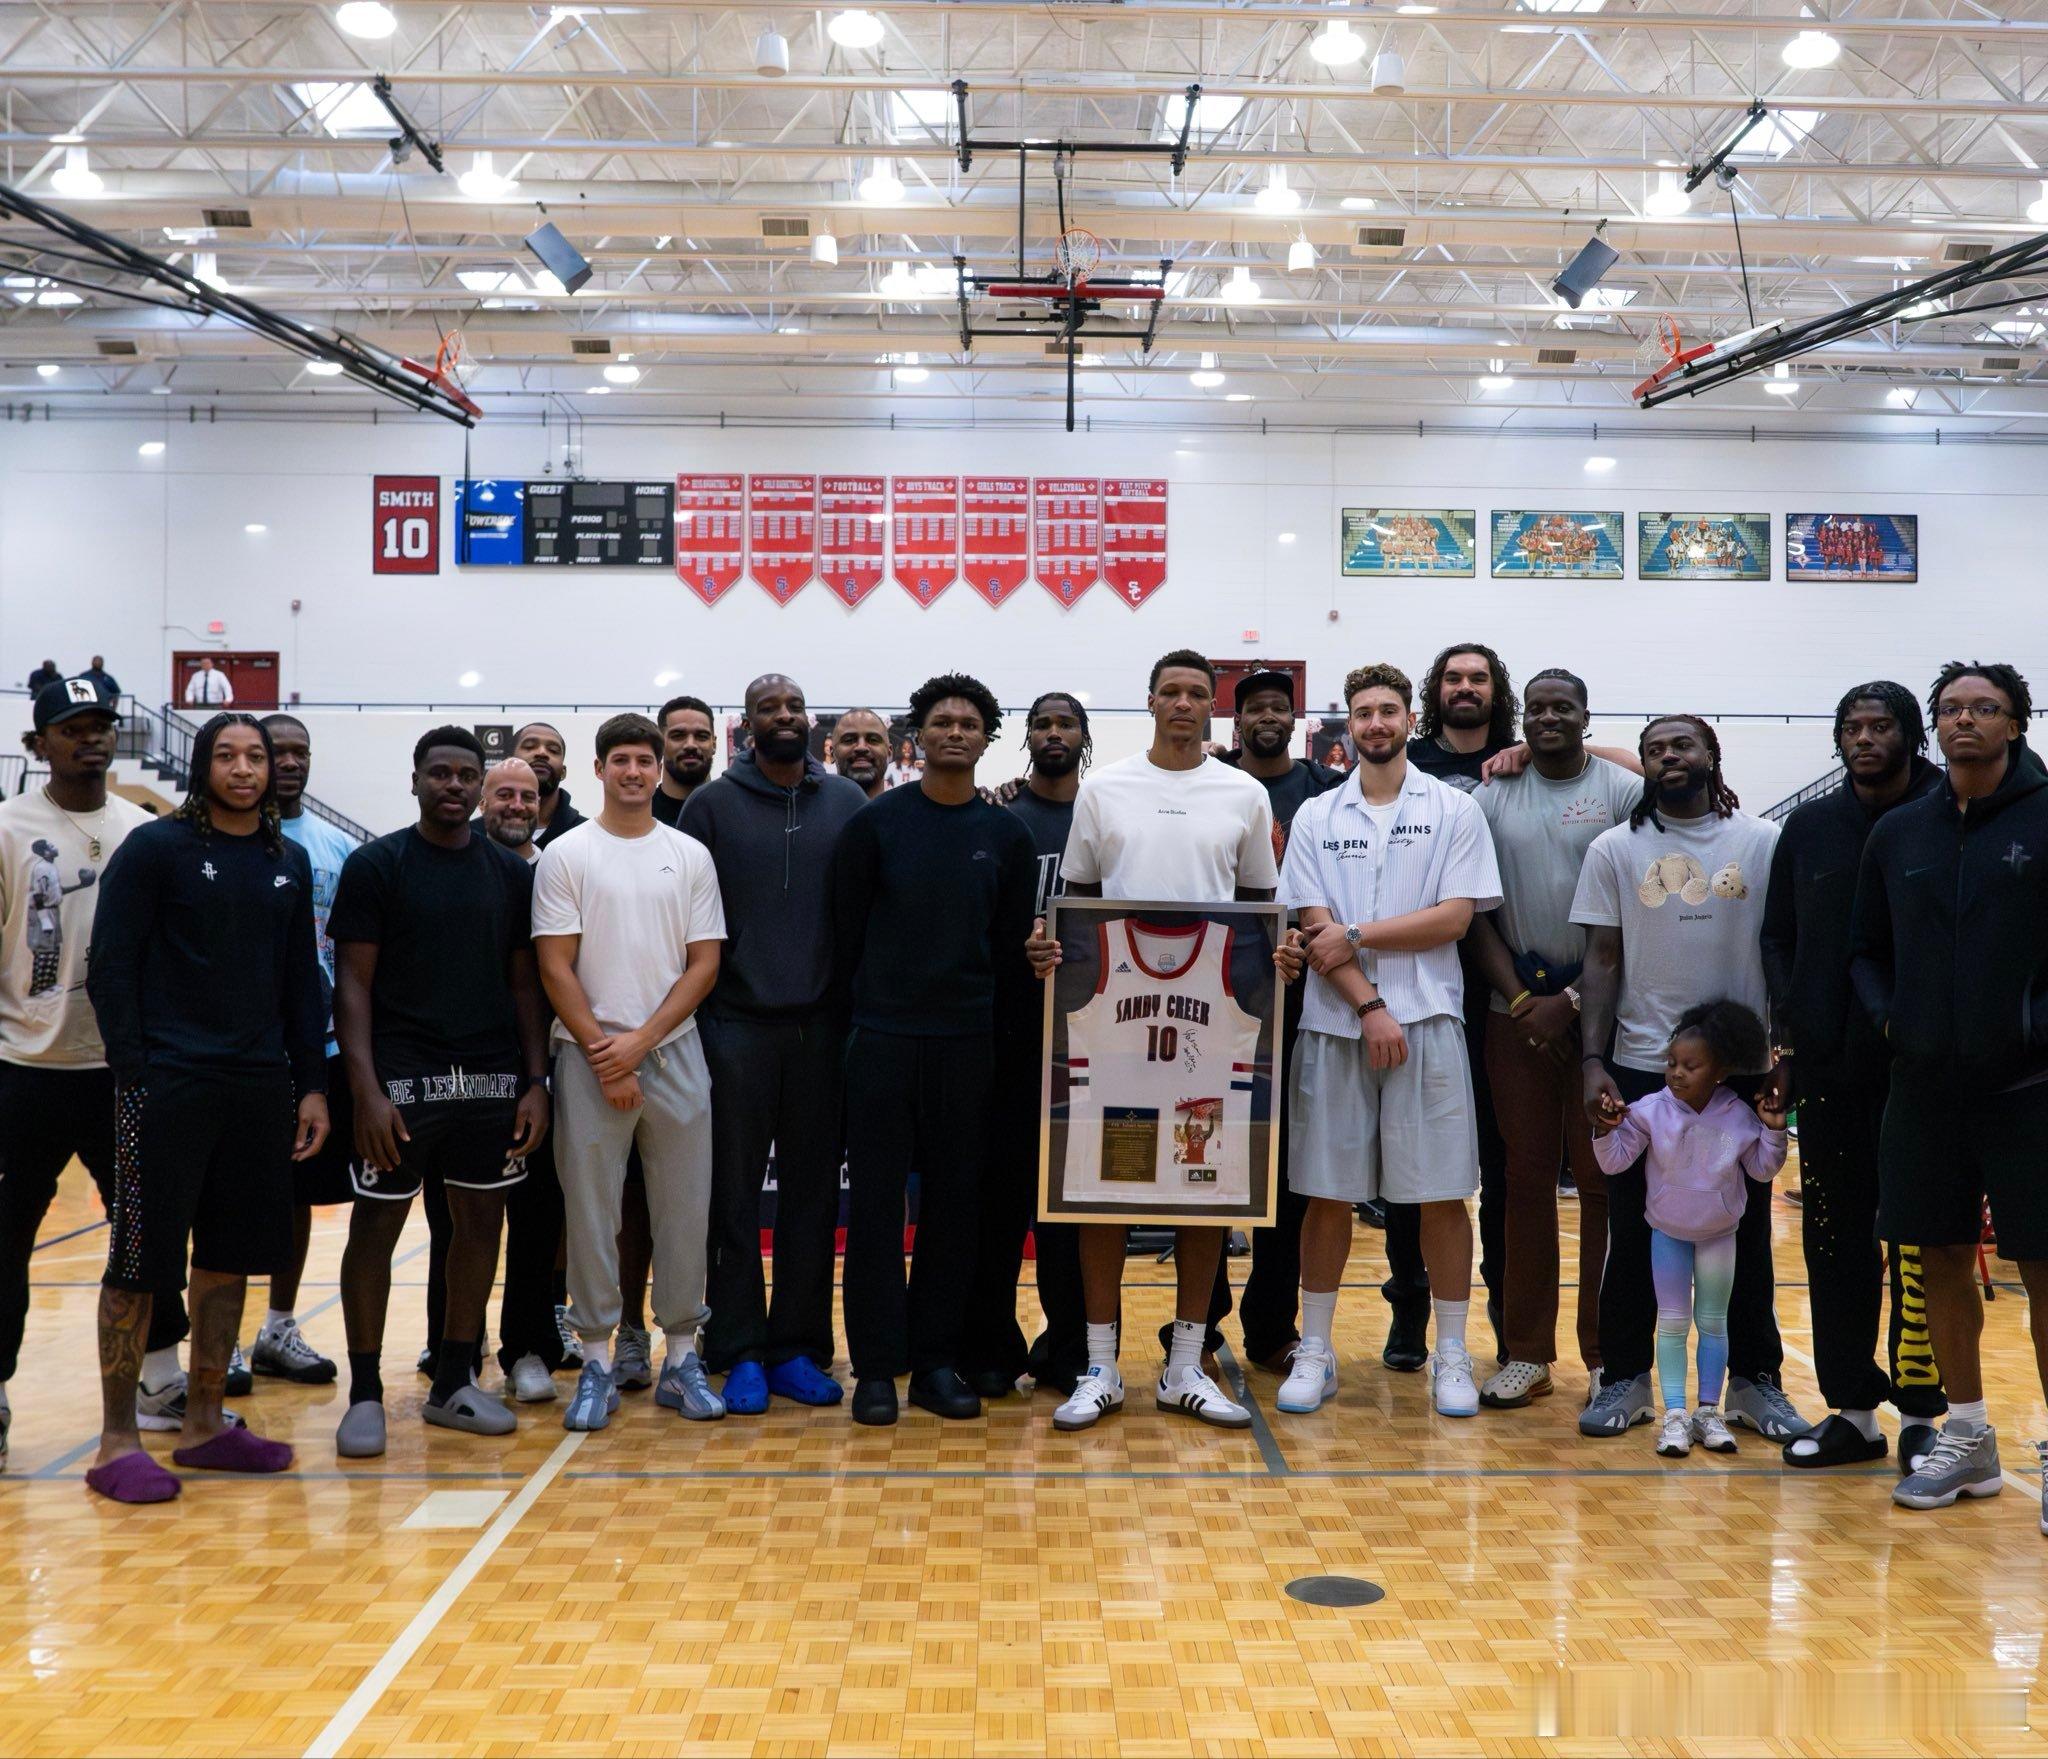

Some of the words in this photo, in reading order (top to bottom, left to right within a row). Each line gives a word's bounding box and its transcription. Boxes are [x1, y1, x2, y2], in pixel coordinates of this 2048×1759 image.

[529, 485, 564, 495] GUEST
[635, 486, 667, 495] HOME
[833, 482, 872, 491] FOOTBALL
[995, 482, 1015, 491] TRACK
[1049, 483, 1086, 493] VOLLEYBALL
[1119, 482, 1133, 490] FAST
[380, 491, 434, 507] SMITH
[571, 515, 603, 524] PERIOD
[383, 518, 429, 558] 10
[1323, 840, 1340, 851] LES
[1344, 840, 1368, 849] BEN
[1115, 994, 1161, 1024] SANDY
[1166, 994, 1210, 1026] CREEK
[1146, 1025, 1178, 1062] 10
[386, 1079, 415, 1105] BE
